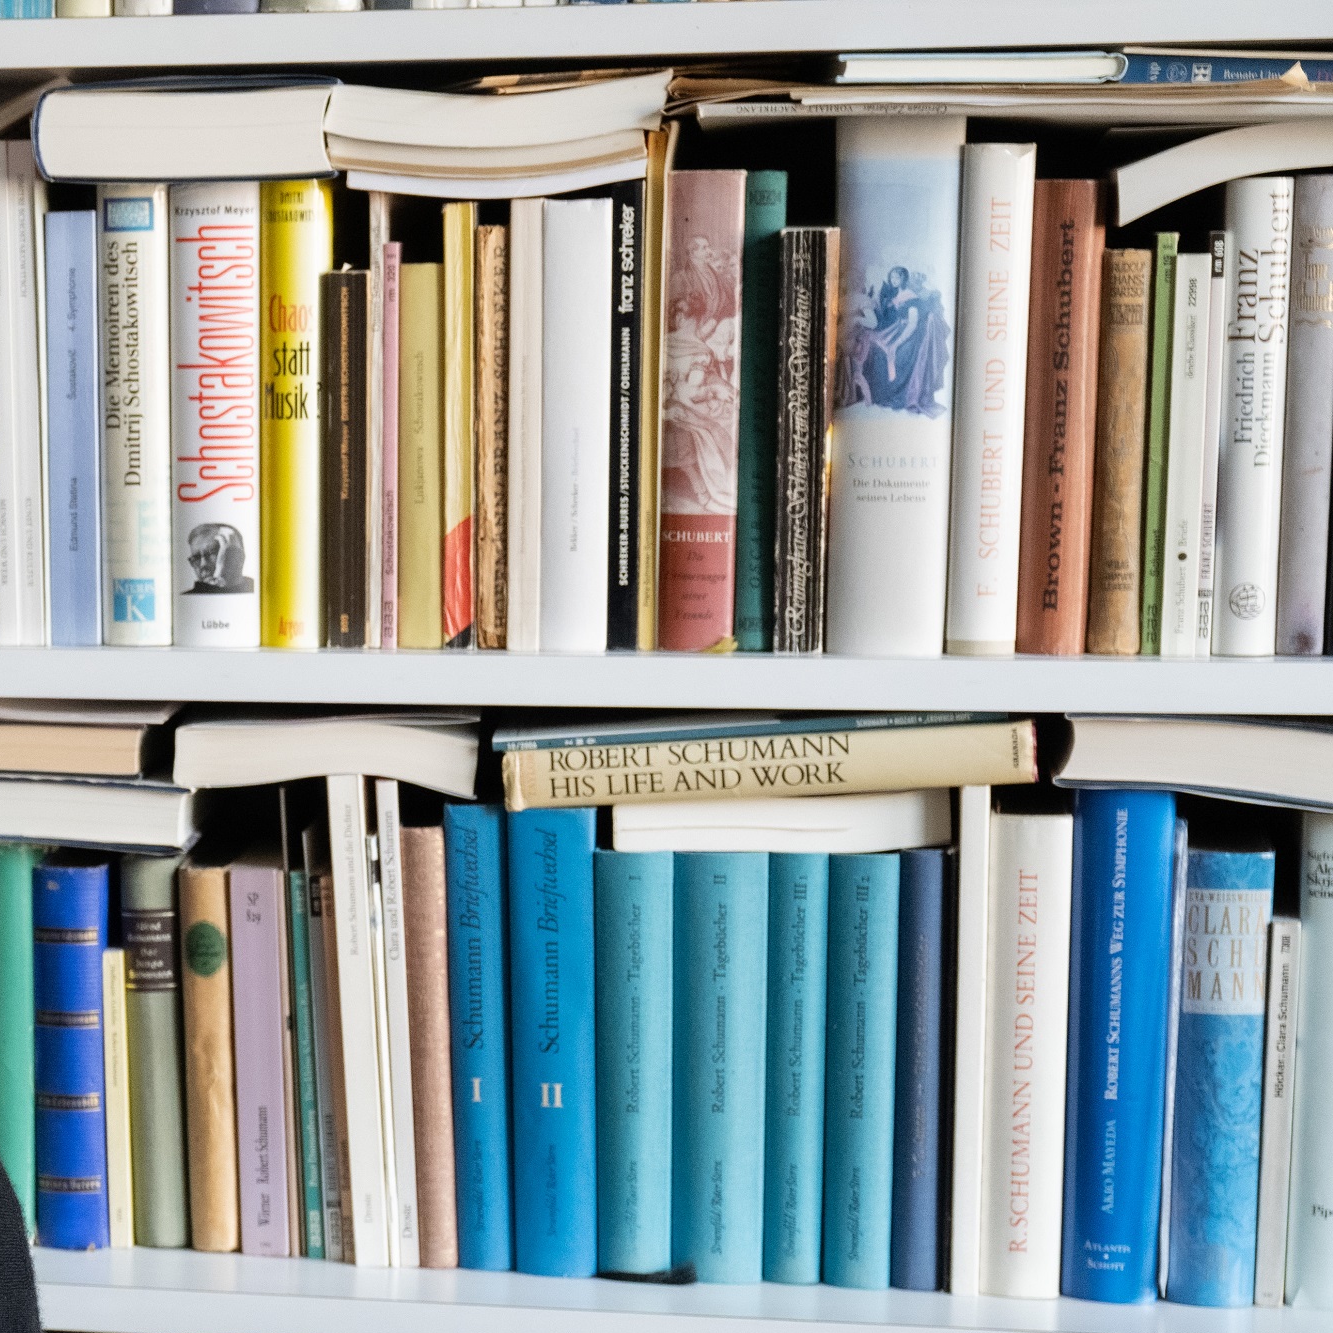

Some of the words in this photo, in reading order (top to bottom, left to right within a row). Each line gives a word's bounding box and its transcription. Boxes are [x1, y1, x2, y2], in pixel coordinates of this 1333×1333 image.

[175, 205, 221, 218] Krzysztof
[224, 204, 255, 216] Meyer
[618, 203, 635, 271] schreker
[990, 197, 1012, 252] ZEIT
[104, 241, 119, 277] des
[1258, 188, 1292, 344] Schubert
[617, 274, 634, 313] franz
[986, 270, 1010, 341] SEINE
[1053, 218, 1076, 371] Schubert
[1226, 248, 1259, 344] Franz
[105, 283, 122, 388] Memoiren
[122, 241, 141, 407] Schostakowitsch
[176, 224, 254, 502] Schostakowitsch
[273, 342, 311, 377] statt
[983, 358, 1006, 412] UND
[106, 393, 122, 431] Die
[264, 381, 309, 421] Musik
[1232, 352, 1255, 444] Friedrich
[1253, 352, 1275, 468] Dieckmann
[123, 413, 143, 487] Dmitrij
[1049, 379, 1068, 479] Franz
[846, 454, 938, 469] SCHUBERT
[979, 430, 1004, 559] SCHUBERT
[662, 530, 730, 543] SCHUBERT
[1043, 501, 1064, 612] Brown
[977, 576, 998, 598] F.
[201, 620, 230, 630] Lübbe
[549, 745, 655, 773] ROBERT
[668, 733, 850, 766] SCHUMANN
[550, 775, 596, 799] HIS
[606, 769, 663, 797] LIFE
[673, 766, 742, 791] AND
[751, 761, 848, 787] WORK
[342, 804, 354, 838] Dichter
[344, 841, 357, 853] die
[382, 810, 396, 866] Schumann
[346, 856, 357, 873] und
[384, 869, 398, 905] Robert
[456, 826, 482, 931] Briefwechsel
[536, 827, 567, 935] Briefwechsel
[713, 874, 726, 885] II
[346, 876, 359, 923] Schumann
[389, 908, 400, 929] und
[1017, 869, 1039, 926] ZEIT
[1188, 905, 1266, 935] CLARA
[348, 924, 360, 956] Robert
[387, 932, 400, 961] Clara
[626, 903, 644, 982] Tagebücher
[712, 902, 730, 982] Tagebücher
[790, 908, 809, 985] Tagebücher
[852, 908, 871, 986] Tagebücher
[462, 936, 485, 1051] Schumann
[538, 940, 561, 1054] Schumann
[1016, 934, 1037, 1005] SEINE
[1187, 971, 1265, 1000] MANN
[1278, 963, 1291, 1020] Schumann
[626, 996, 641, 1064] Schumann
[712, 996, 726, 1064] Schumann
[788, 999, 804, 1067] Schumann
[851, 1001, 867, 1070] Schumann
[1013, 1013, 1035, 1071] UND
[626, 1069, 641, 1114] Robert
[712, 1069, 726, 1114] Robert
[788, 1071, 803, 1117] Robert
[850, 1075, 864, 1120] Robert
[1010, 1079, 1033, 1228] SCHUMANN
